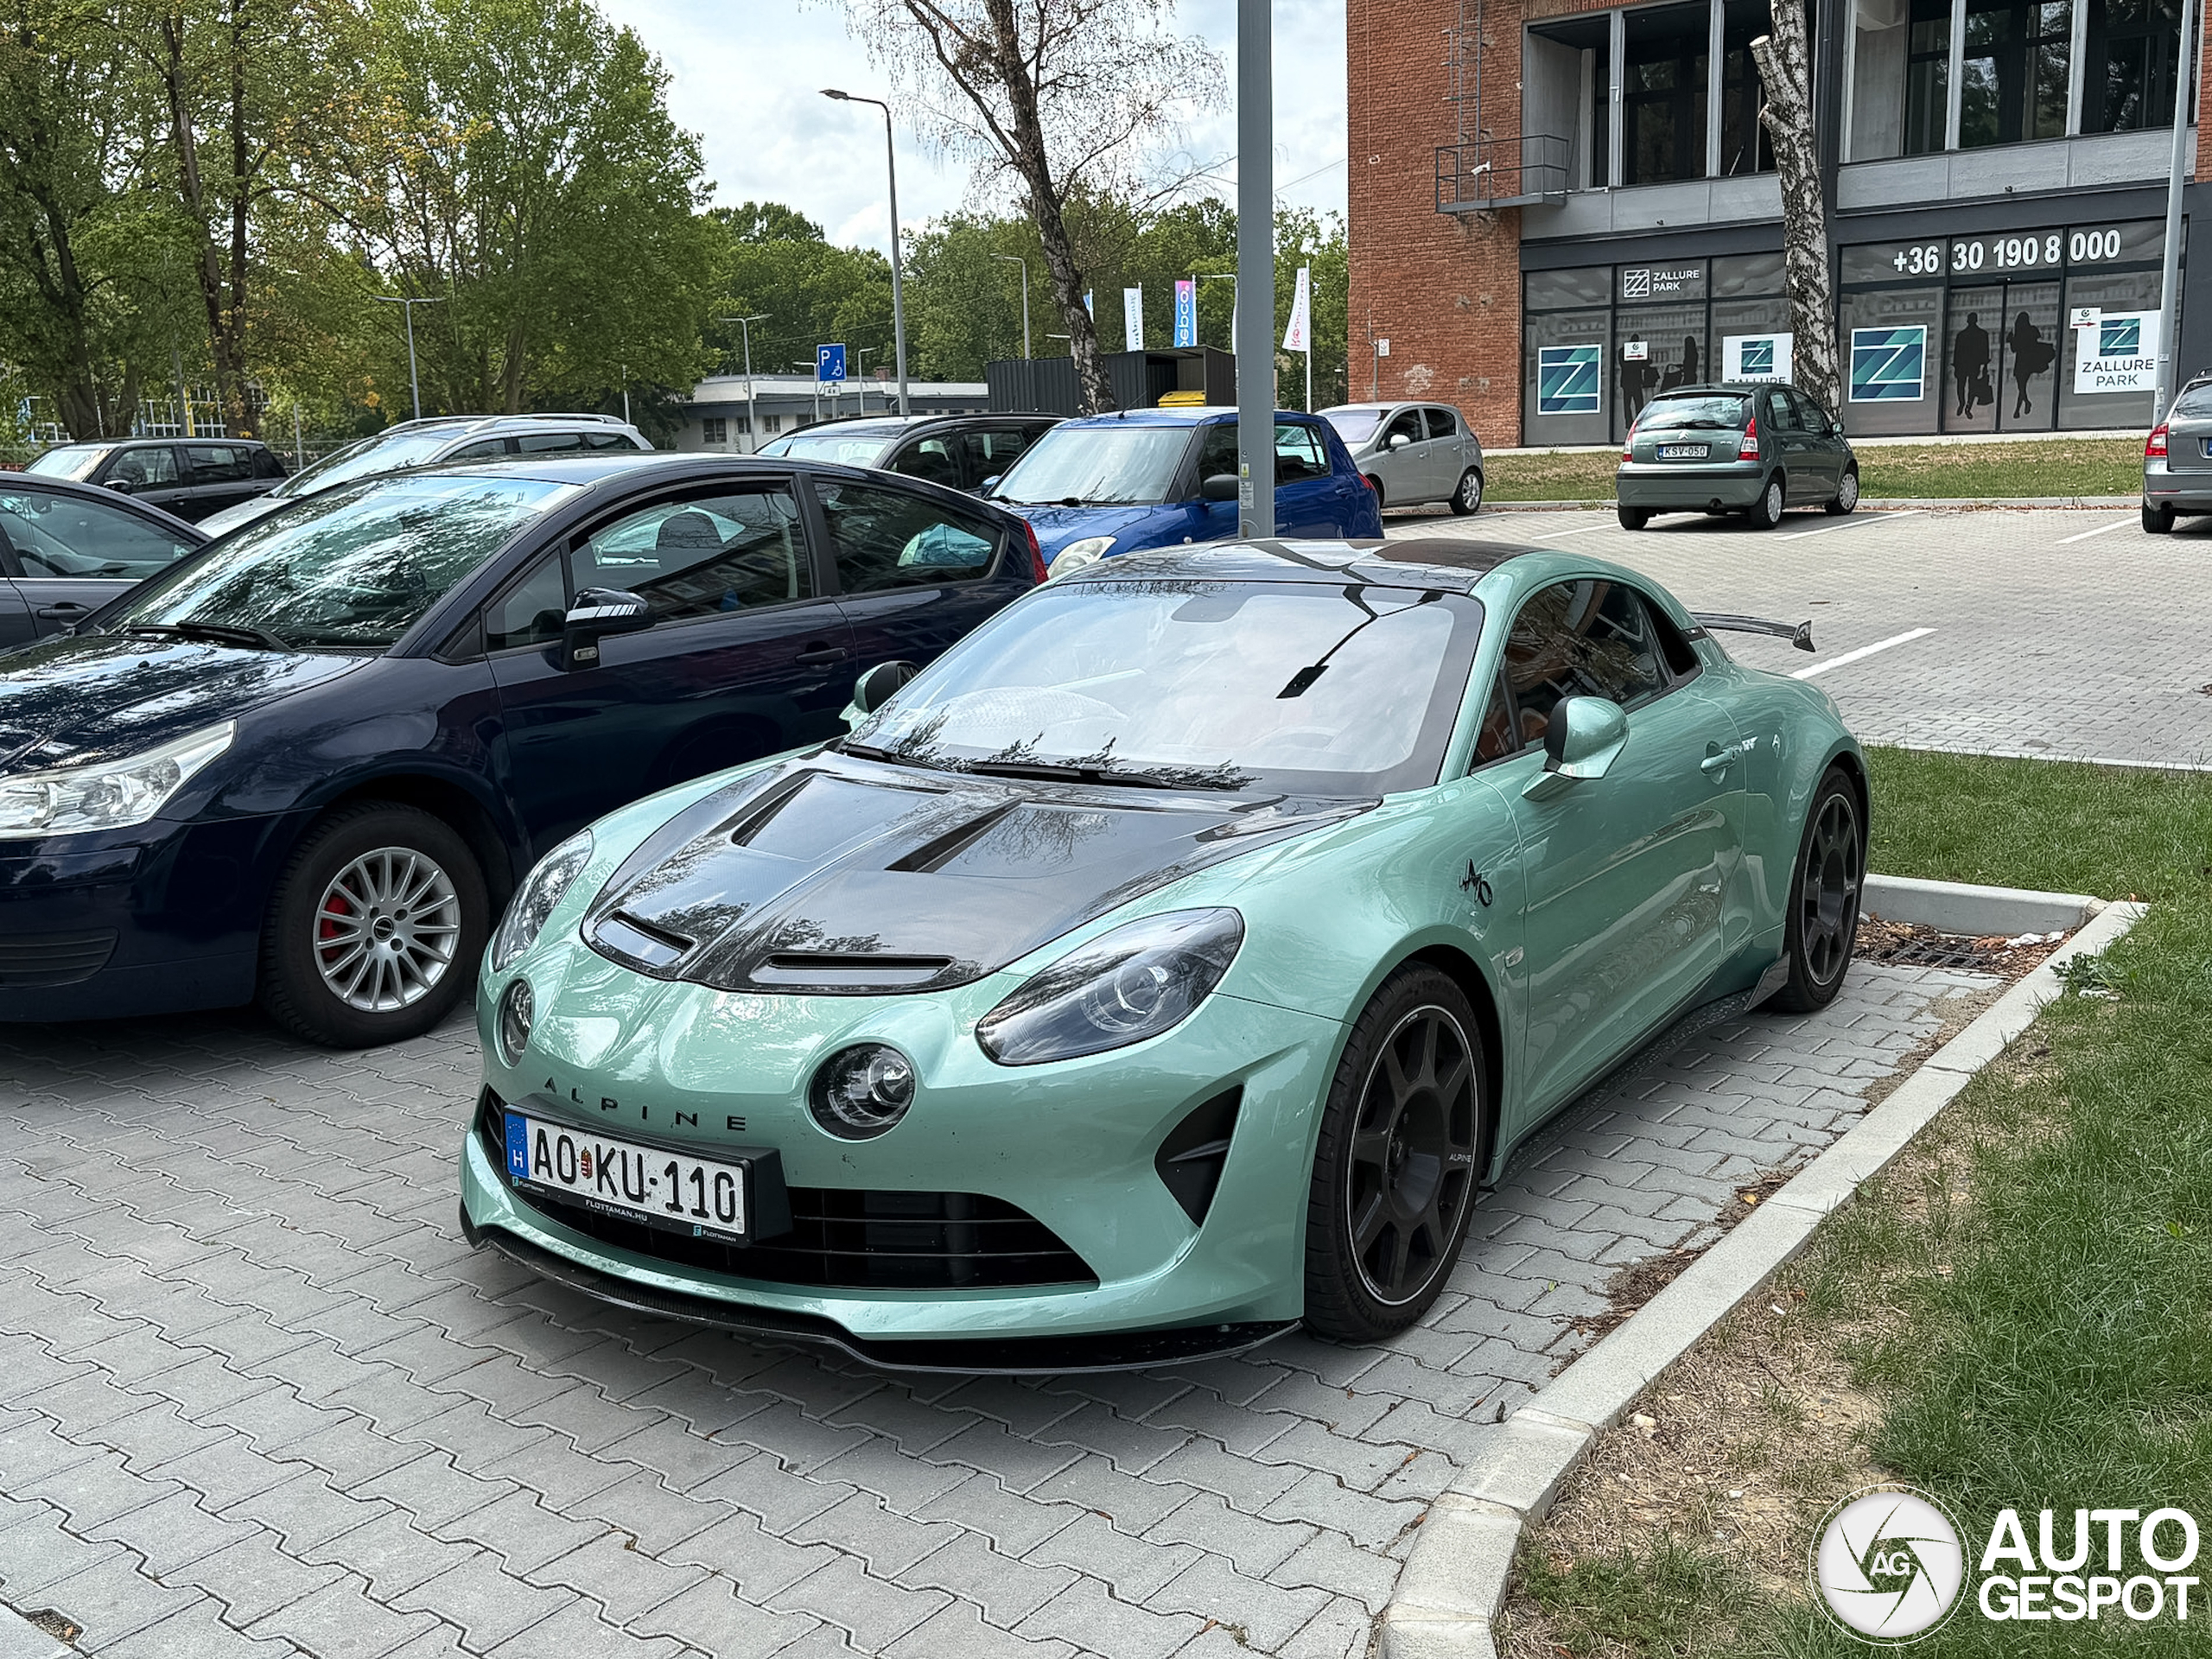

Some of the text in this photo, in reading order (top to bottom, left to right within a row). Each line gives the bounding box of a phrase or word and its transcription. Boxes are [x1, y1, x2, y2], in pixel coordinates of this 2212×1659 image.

[1893, 229, 2121, 275] +36 30 190 8 000
[1653, 270, 1700, 282] ZALLURE
[1653, 282, 1681, 292] PARK
[821, 350, 830, 366] P
[2082, 359, 2155, 373] ZALLURE
[2095, 374, 2139, 386] PARK
[1664, 447, 1706, 456] KSV-050
[544, 1077, 747, 1132] ALPINE
[512, 1149, 524, 1168] H
[534, 1128, 736, 1224] AO KU-110
[585, 1199, 648, 1222] FLOTTAMAN.HU
[702, 1230, 736, 1243] FLOTTAMAN
